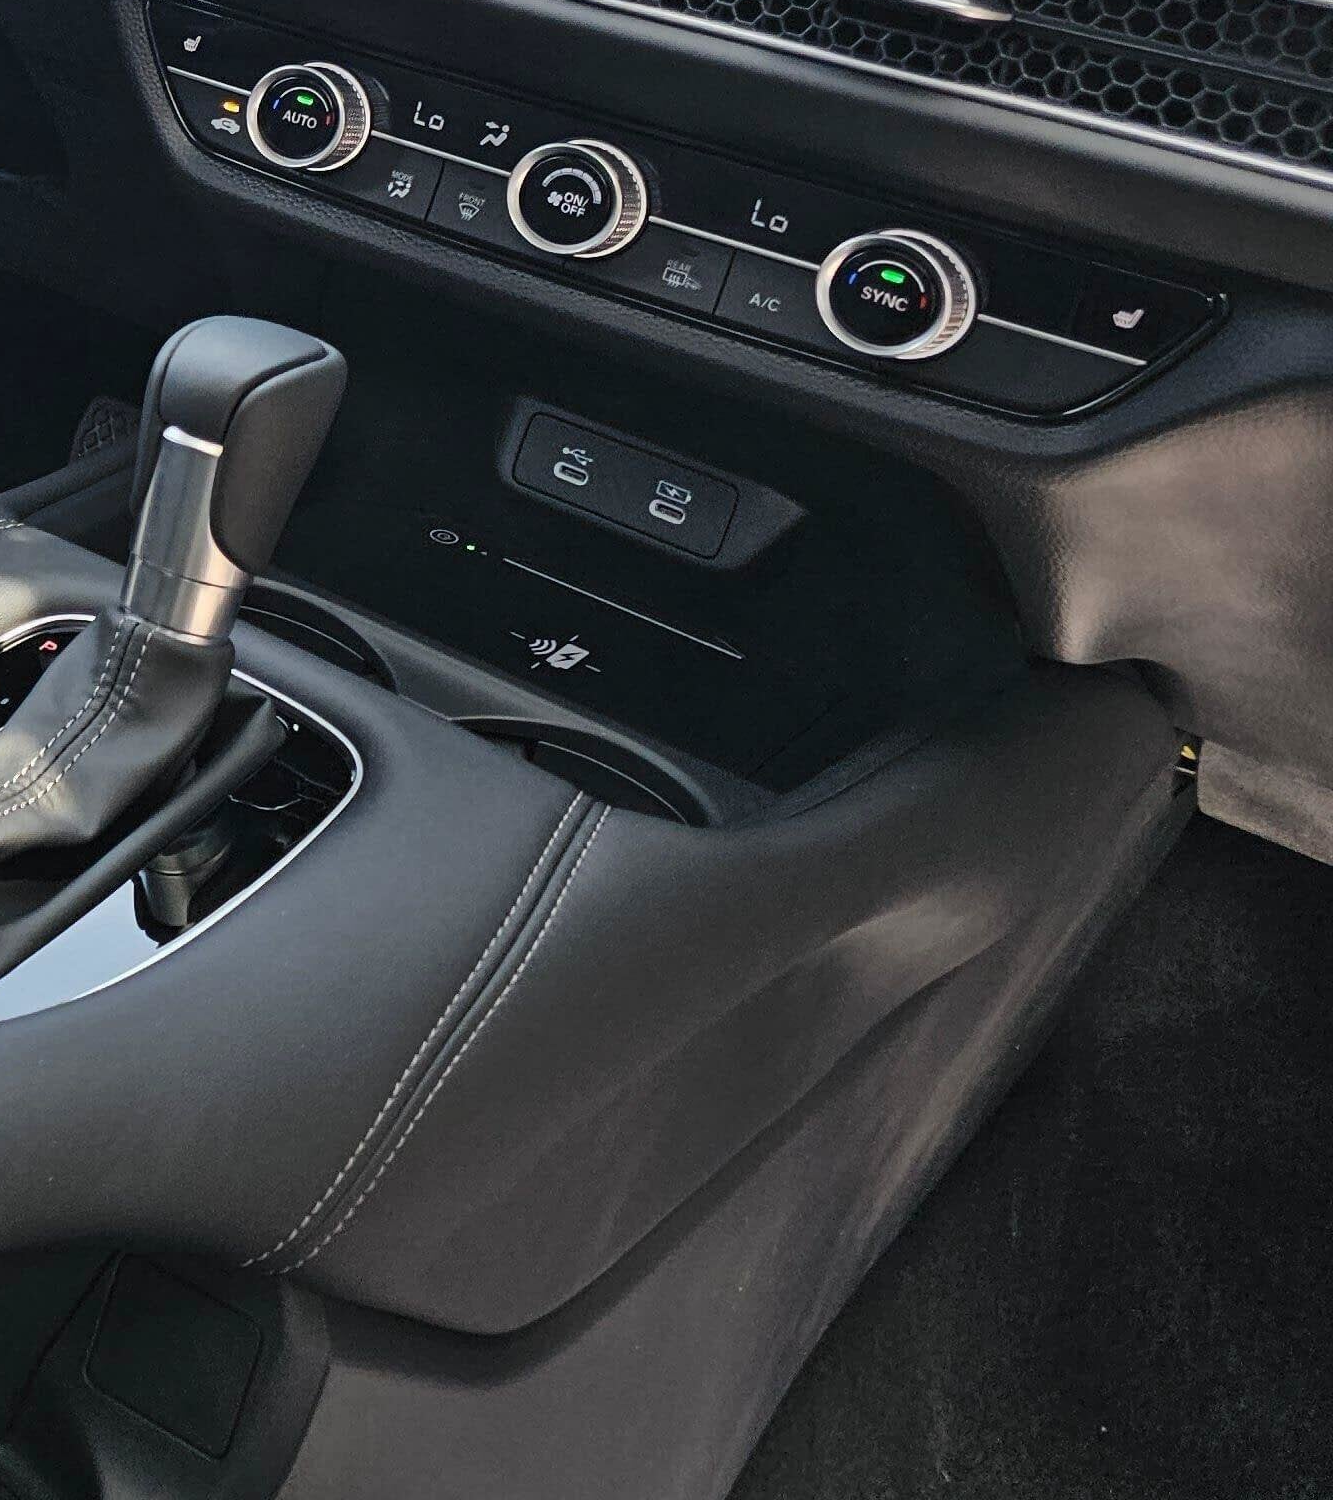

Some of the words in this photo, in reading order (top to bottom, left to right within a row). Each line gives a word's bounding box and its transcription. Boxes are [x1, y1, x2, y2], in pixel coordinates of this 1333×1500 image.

[282, 110, 318, 131] AUTO
[413, 101, 445, 131] Lo
[563, 190, 589, 210] ON/
[560, 203, 587, 219] OFF
[750, 197, 789, 234] Lo
[749, 291, 781, 313] A/C
[860, 286, 908, 312] SYNC
[38, 639, 58, 654] P
